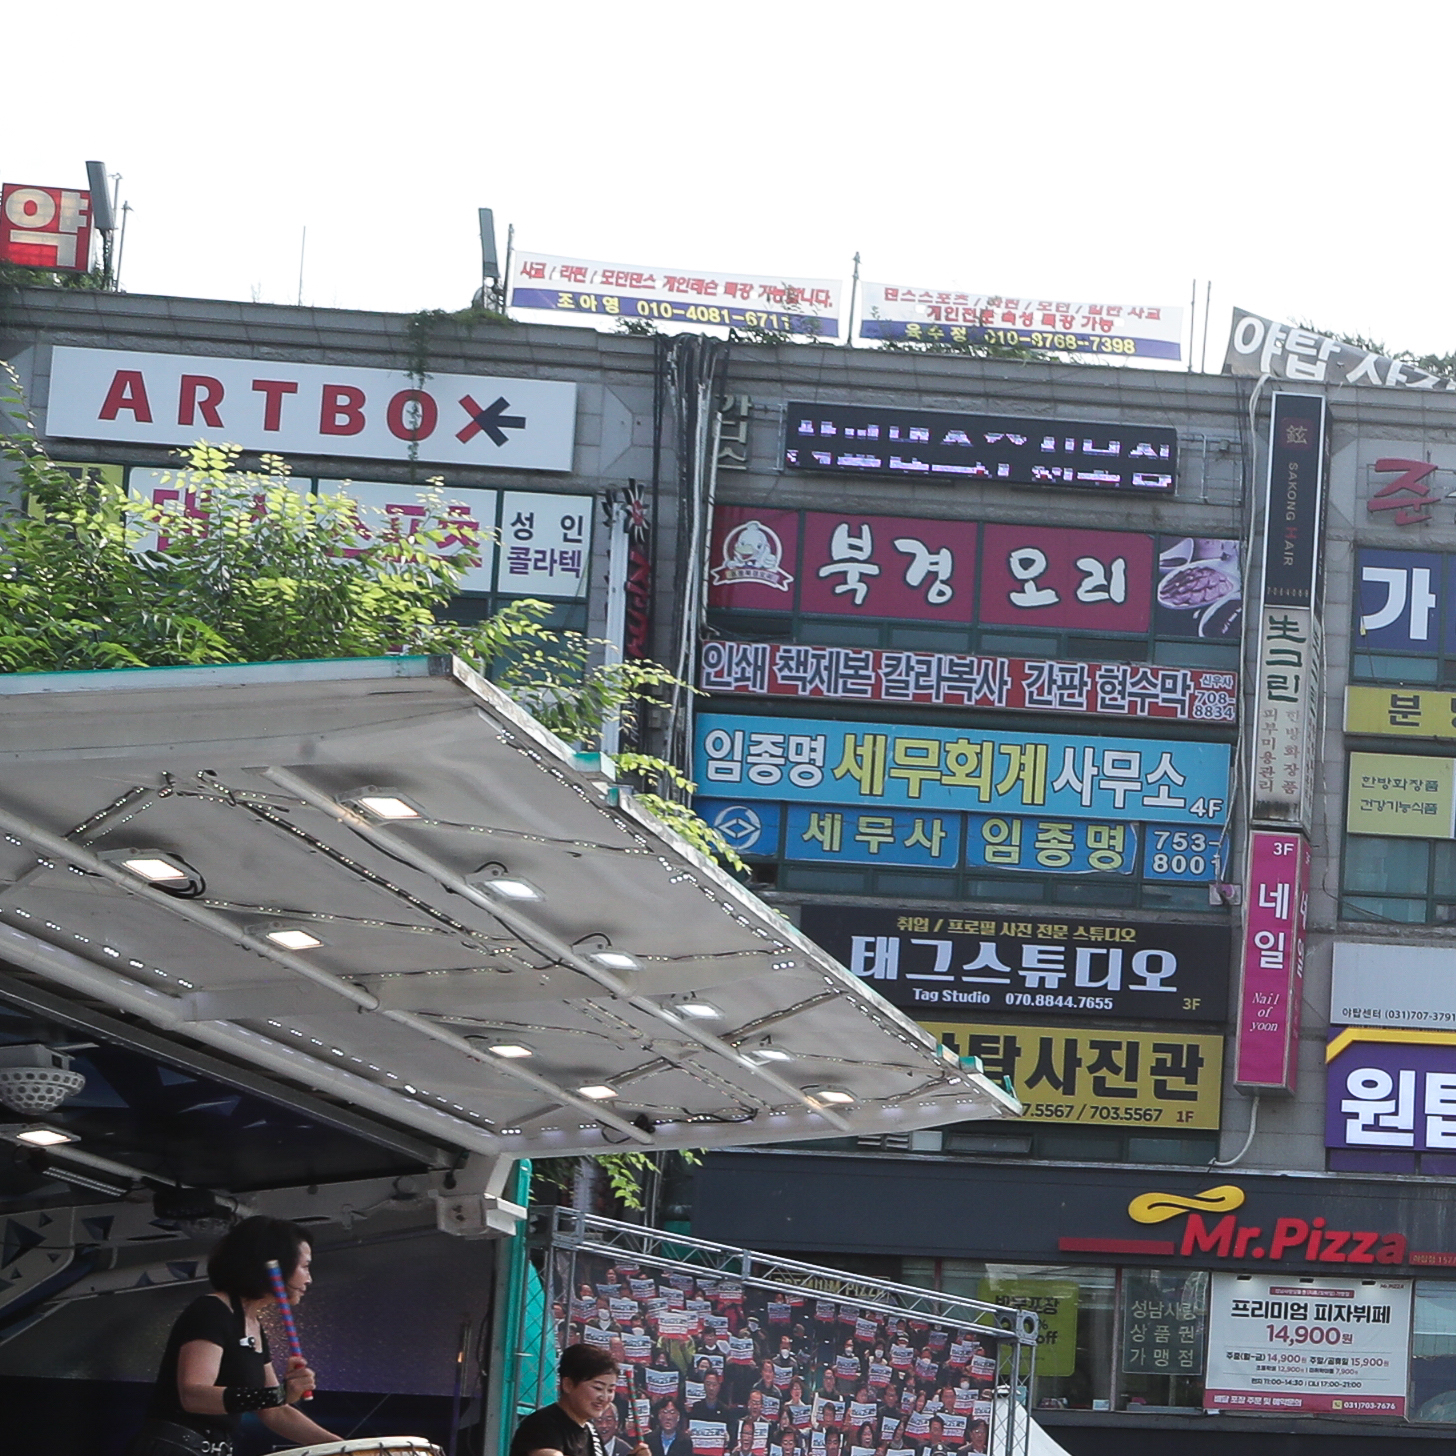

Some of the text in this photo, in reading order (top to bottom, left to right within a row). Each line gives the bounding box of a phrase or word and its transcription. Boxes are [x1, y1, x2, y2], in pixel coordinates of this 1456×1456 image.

[2, 186, 89, 268] 약
[557, 292, 621, 314] 조아영
[1233, 315, 1341, 381] 야탑
[98, 368, 526, 448] ARTBOX
[1282, 461, 1299, 567] SAKONG HAIR
[507, 544, 583, 579] 콜라텍
[819, 521, 1126, 607] 북경 오리
[701, 641, 1191, 722] 인쇄 책제본 칼라복사 간판 현수막
[1201, 673, 1234, 690] 신우사
[1193, 704, 1234, 722] 8834
[703, 729, 1224, 819] 임종명 세무회계 사무소 4F
[1360, 774, 1440, 794] 한방화장품
[802, 811, 1127, 870] 세무사 임종명
[1273, 842, 1295, 856] 3F
[1152, 852, 1223, 874] 8001
[896, 915, 1137, 943] 취업 프로필 사진 전문 스튜디오
[1254, 882, 1291, 970] 네일
[850, 934, 1179, 993] 태그스튜디오
[912, 987, 1114, 1010] Tag Studio 070.8844.7655
[1182, 998, 1202, 1011] 3F
[1252, 991, 1280, 1006] Nail
[1257, 1006, 1273, 1019] of
[1342, 1006, 1456, 1023] 야탑센터 (031)707-3791
[1250, 1020, 1279, 1033] yoon
[1090, 1104, 1194, 1123] 703.5567 1F
[1179, 1213, 1408, 1265] Mr.Pizza
[1230, 1299, 1392, 1324] 프리미엄 피자뷔페
[1130, 1324, 1195, 1345] 상품권
[1129, 1347, 1196, 1368] 가맹점
